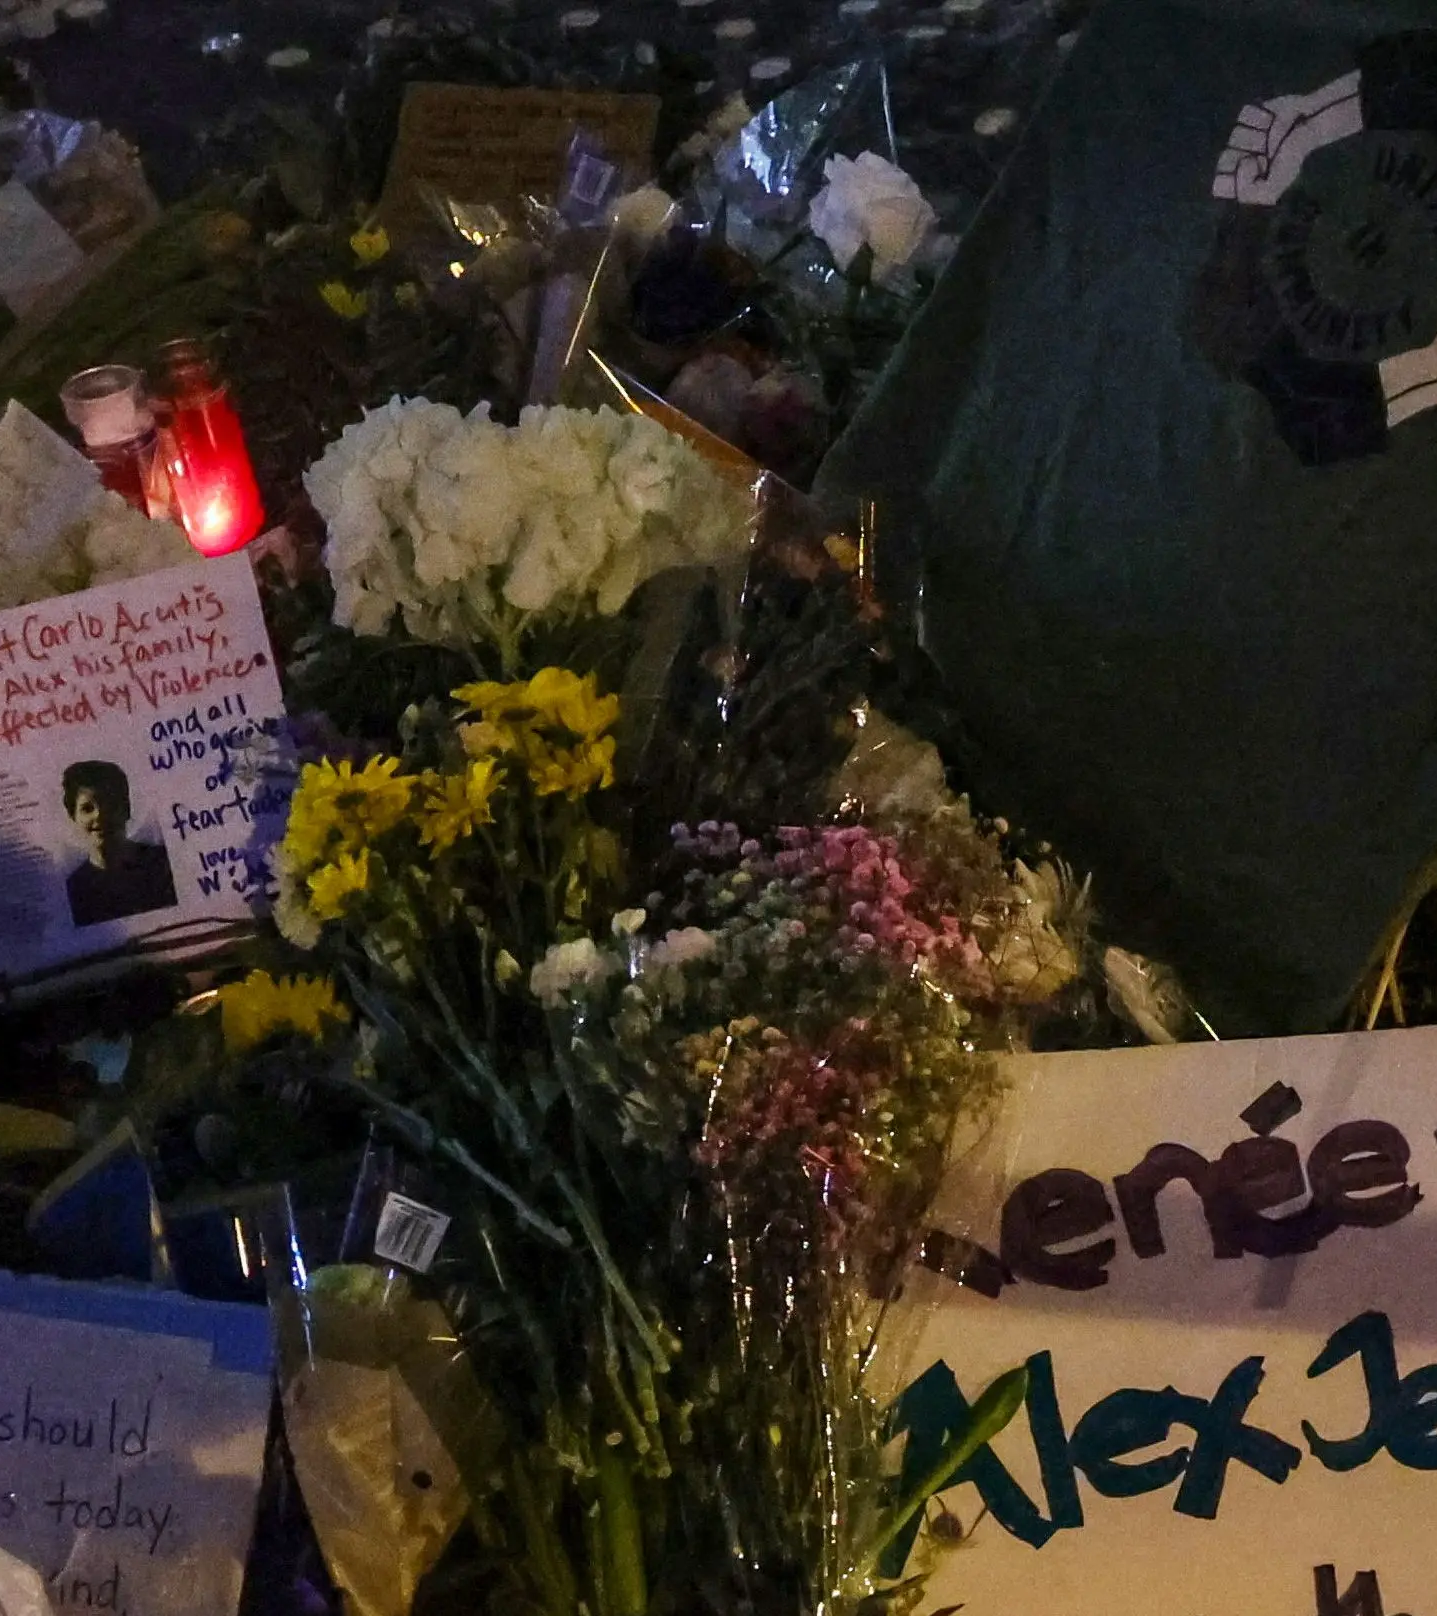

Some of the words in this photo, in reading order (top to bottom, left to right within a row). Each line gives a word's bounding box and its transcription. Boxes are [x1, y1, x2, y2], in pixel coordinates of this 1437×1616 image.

[21, 610, 105, 664] Carlo
[112, 584, 225, 643] Acutis
[71, 648, 117, 678] his
[119, 624, 229, 682] family,
[100, 682, 134, 714] by
[149, 705, 205, 743] and
[207, 692, 248, 724] all
[148, 736, 206, 772] who
[170, 798, 228, 842] fear
[877, 1348, 1302, 1580] Alex
